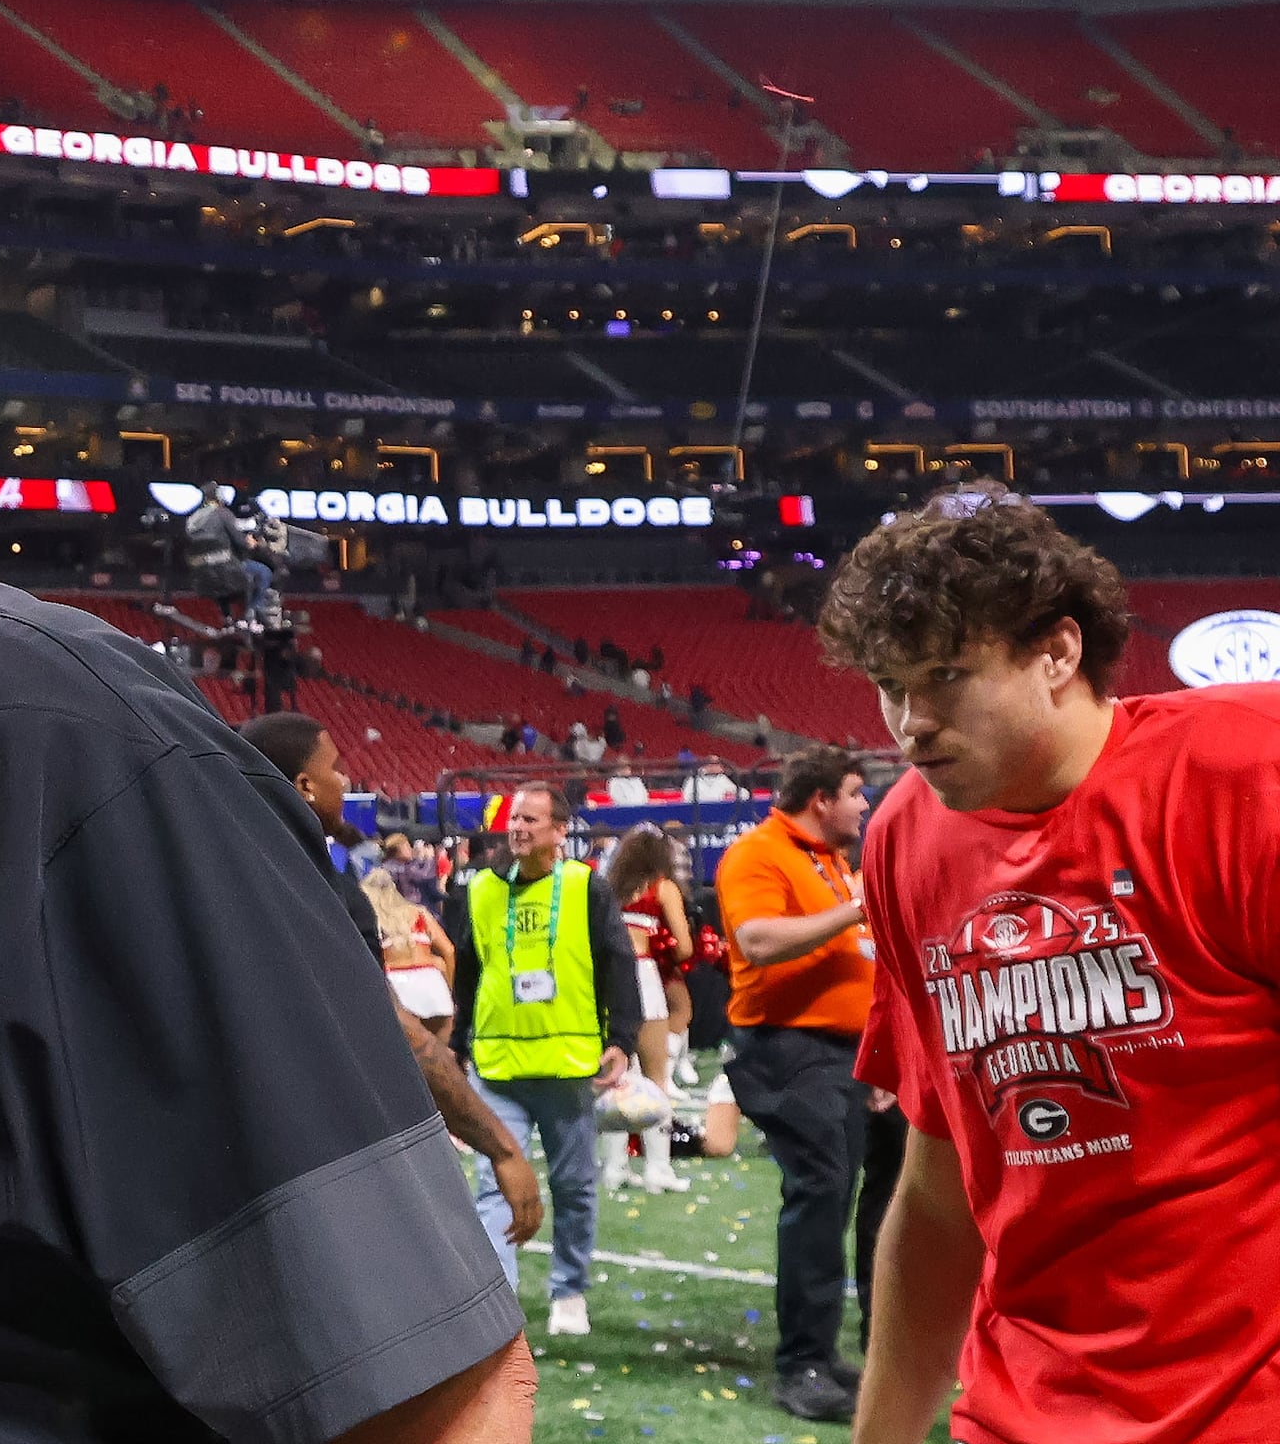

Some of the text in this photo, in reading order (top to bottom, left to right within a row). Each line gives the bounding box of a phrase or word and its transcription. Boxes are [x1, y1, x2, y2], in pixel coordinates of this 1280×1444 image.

[1, 126, 430, 195] GEORGIA BULLDOGS
[176, 382, 212, 401] SEC
[219, 386, 317, 407] FOOTBALL
[257, 489, 714, 527] GEORGIA BULLDOGS
[925, 911, 1120, 974] 20 25
[986, 1041, 1080, 1086] GEORGIA
[1020, 1099, 1070, 1141] G
[1086, 1134, 1133, 1155] MORE
